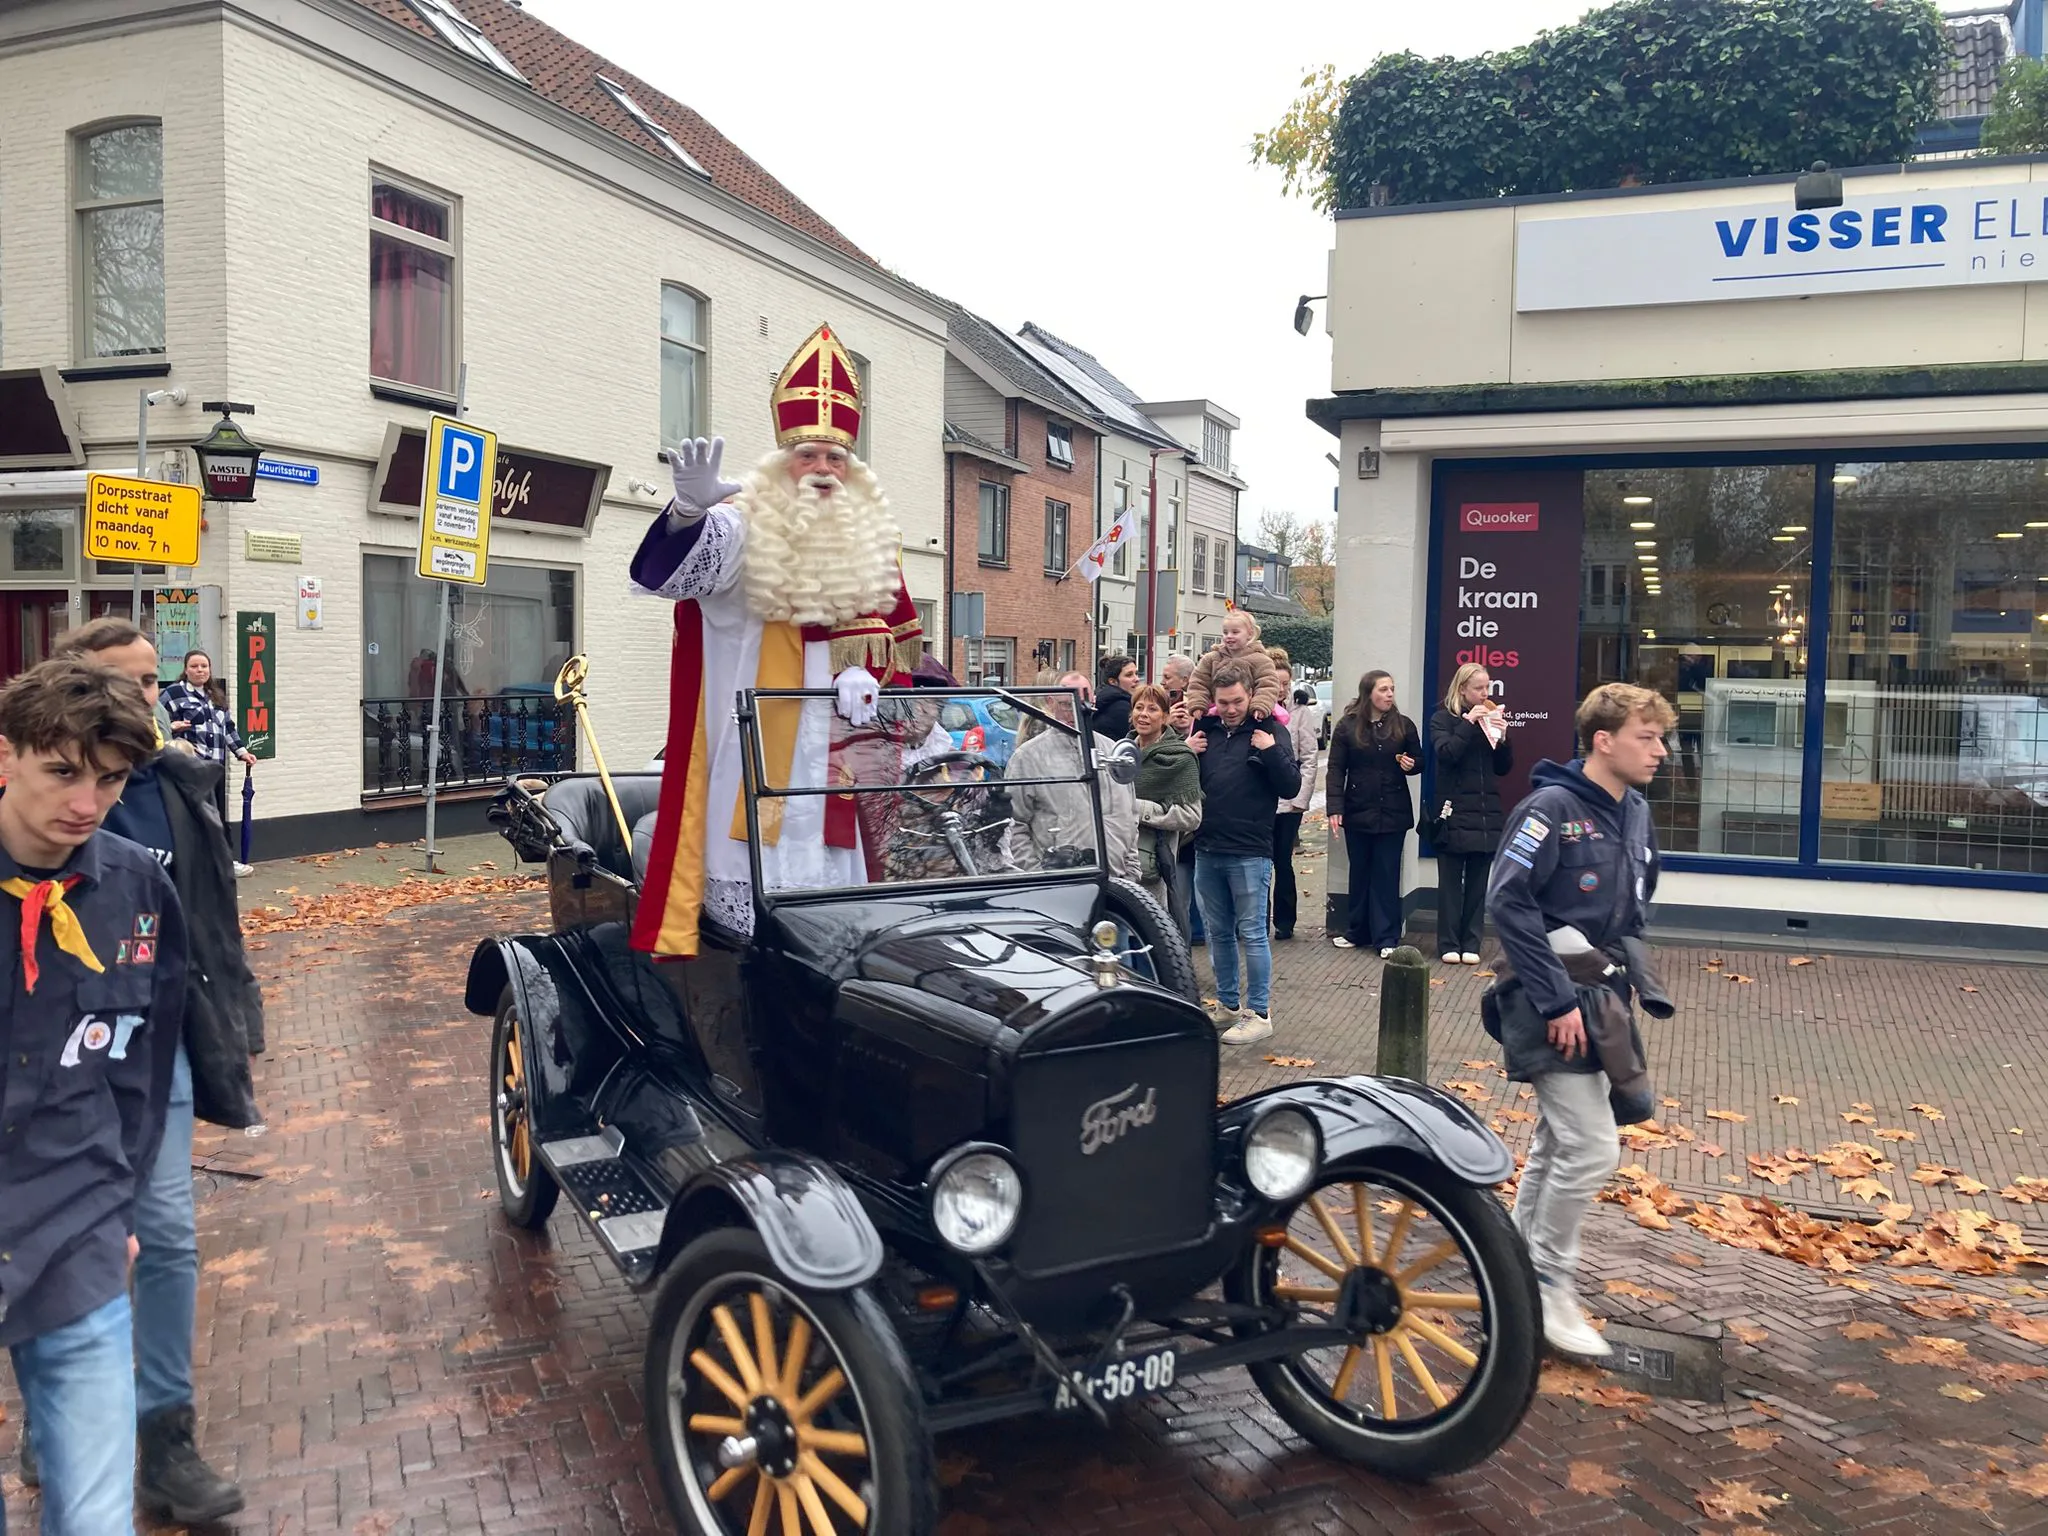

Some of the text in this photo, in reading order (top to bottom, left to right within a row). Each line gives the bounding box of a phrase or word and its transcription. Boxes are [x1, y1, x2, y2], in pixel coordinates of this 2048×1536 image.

[1714, 196, 2048, 258] VISSER EL
[210, 464, 248, 475] AMSTEL
[448, 437, 475, 490] P
[496, 455, 510, 465] afé
[257, 463, 312, 478] Mauritsstraat
[97, 482, 172, 503] Dorpsstraat
[493, 467, 532, 515] olyk
[96, 501, 169, 520] dicht vanaf
[436, 503, 478, 516] parkeren verboden
[439, 512, 476, 526] vanaf woensdag
[1466, 509, 1532, 526] Quooker
[96, 520, 154, 539] maandag
[444, 521, 467, 531] november
[95, 535, 170, 554] 10 nov. 7 h
[444, 537, 481, 550] werkzaamheden
[1460, 557, 1497, 579] De
[300, 588, 321, 599] Duvel
[1458, 586, 1538, 608] kraan
[1457, 615, 1499, 638] die
[1455, 645, 1520, 668] alles
[247, 635, 269, 733] PALM
[1514, 711, 1549, 721] gekoeld
[1080, 1082, 1156, 1155] Ford
